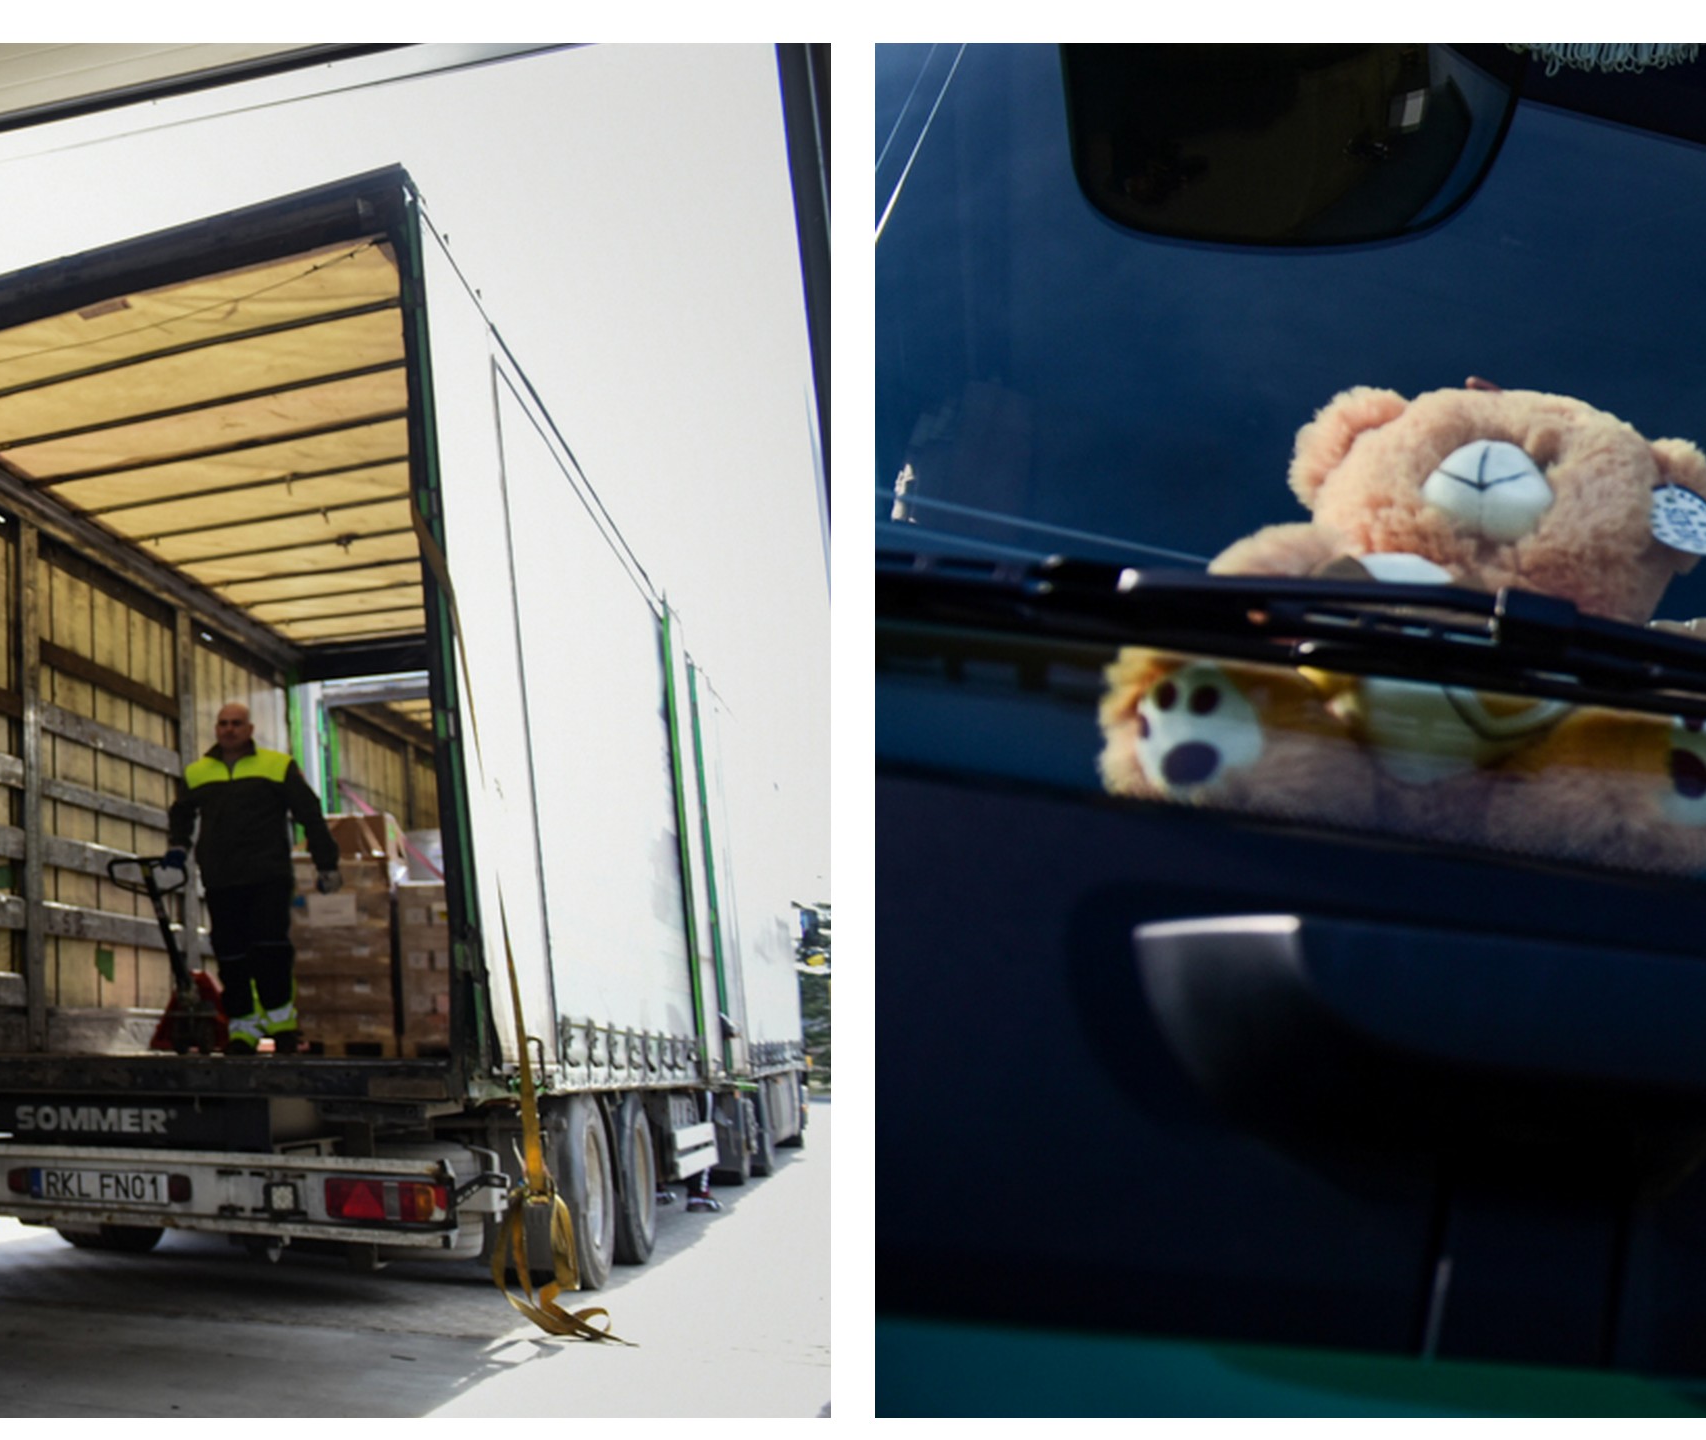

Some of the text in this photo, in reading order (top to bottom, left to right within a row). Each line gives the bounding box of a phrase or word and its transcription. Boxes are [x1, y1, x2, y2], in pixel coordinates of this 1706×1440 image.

[15, 1104, 168, 1133] SOMMER
[45, 1171, 159, 1201] RKL FN01
